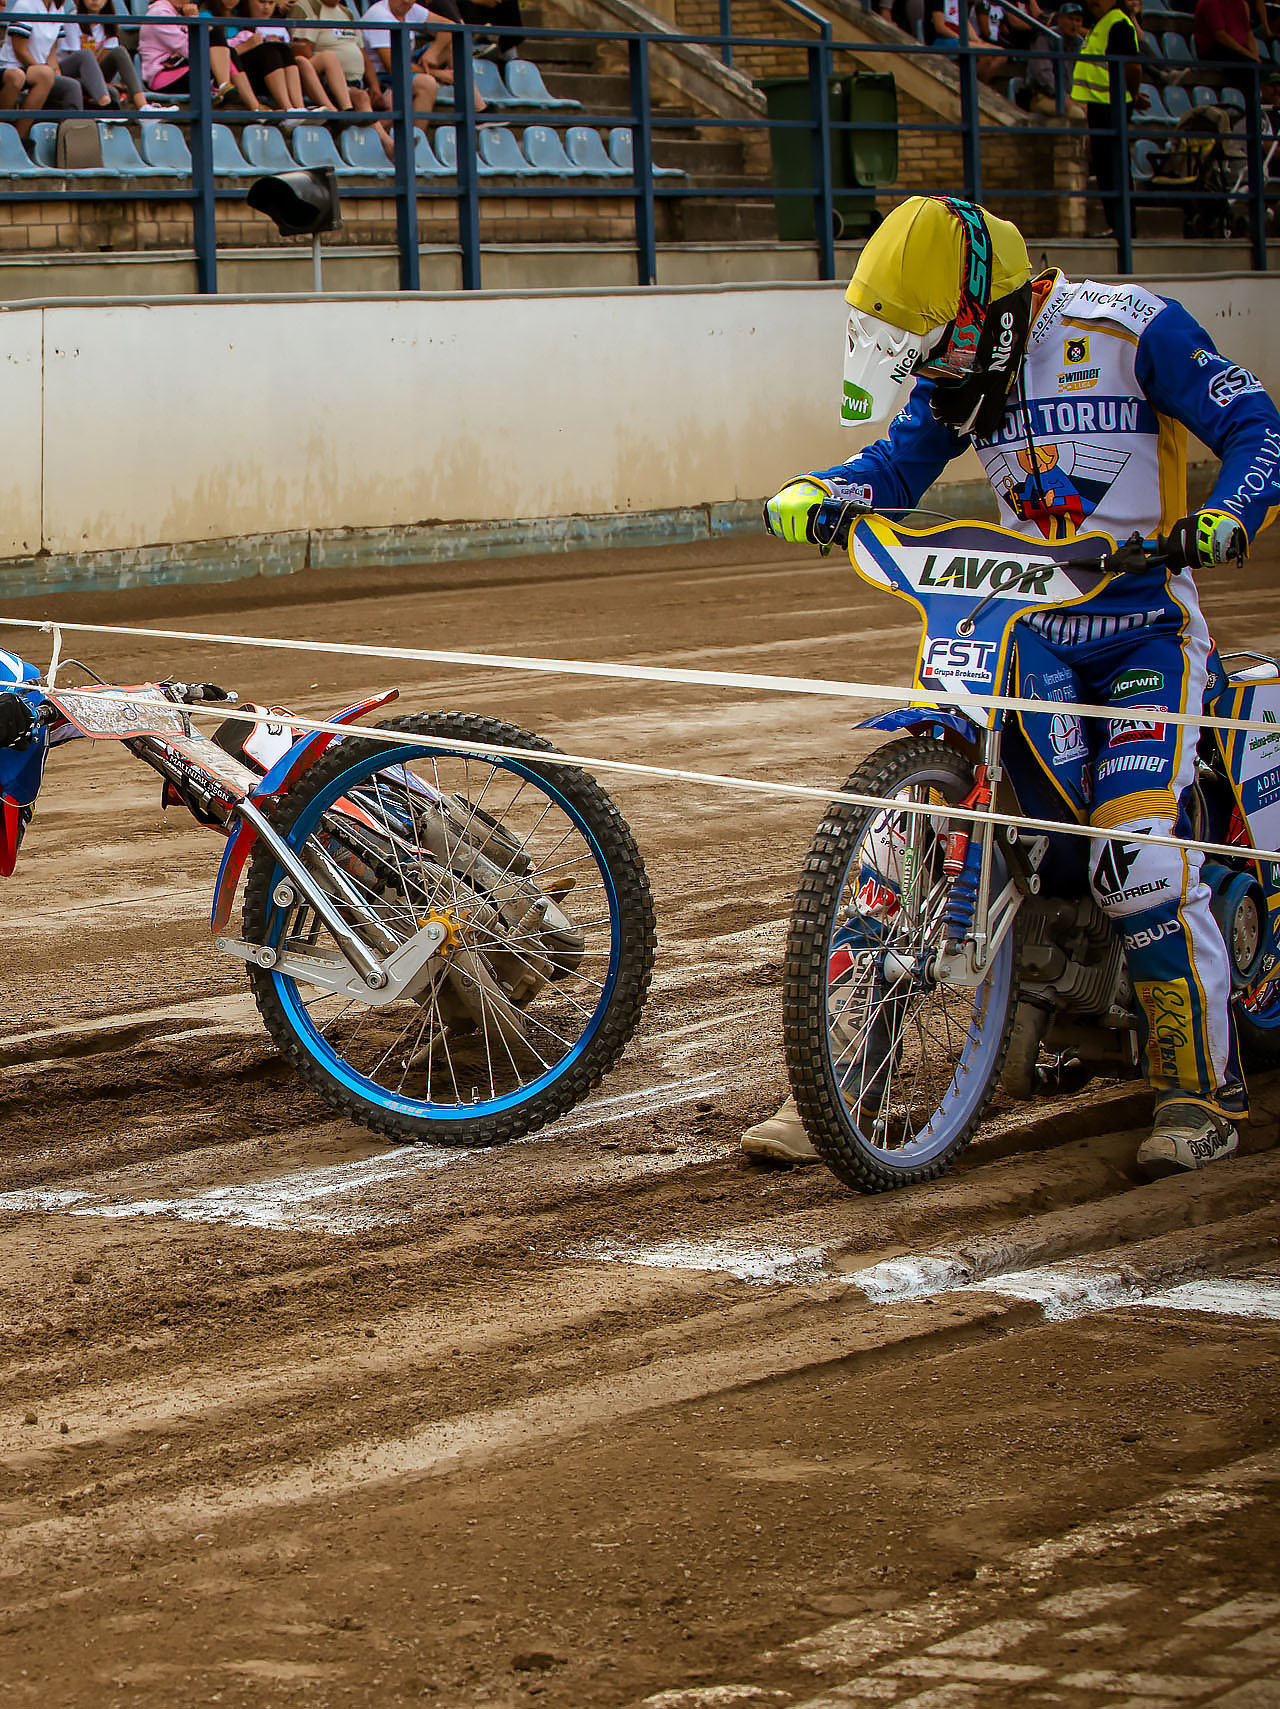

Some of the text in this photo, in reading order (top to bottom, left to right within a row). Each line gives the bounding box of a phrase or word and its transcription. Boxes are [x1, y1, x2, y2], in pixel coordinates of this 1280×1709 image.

[1032, 293, 1069, 338] ADRIANA
[989, 312, 1014, 373] Nice
[890, 347, 918, 385] Nice
[841, 394, 870, 415] rwit
[1039, 397, 1138, 435] TORUŃ
[918, 555, 1054, 595] LAVOR
[927, 641, 994, 669] FST
[934, 668, 990, 680] Grupa Brokerska
[1124, 878, 1170, 900] FRELIK
